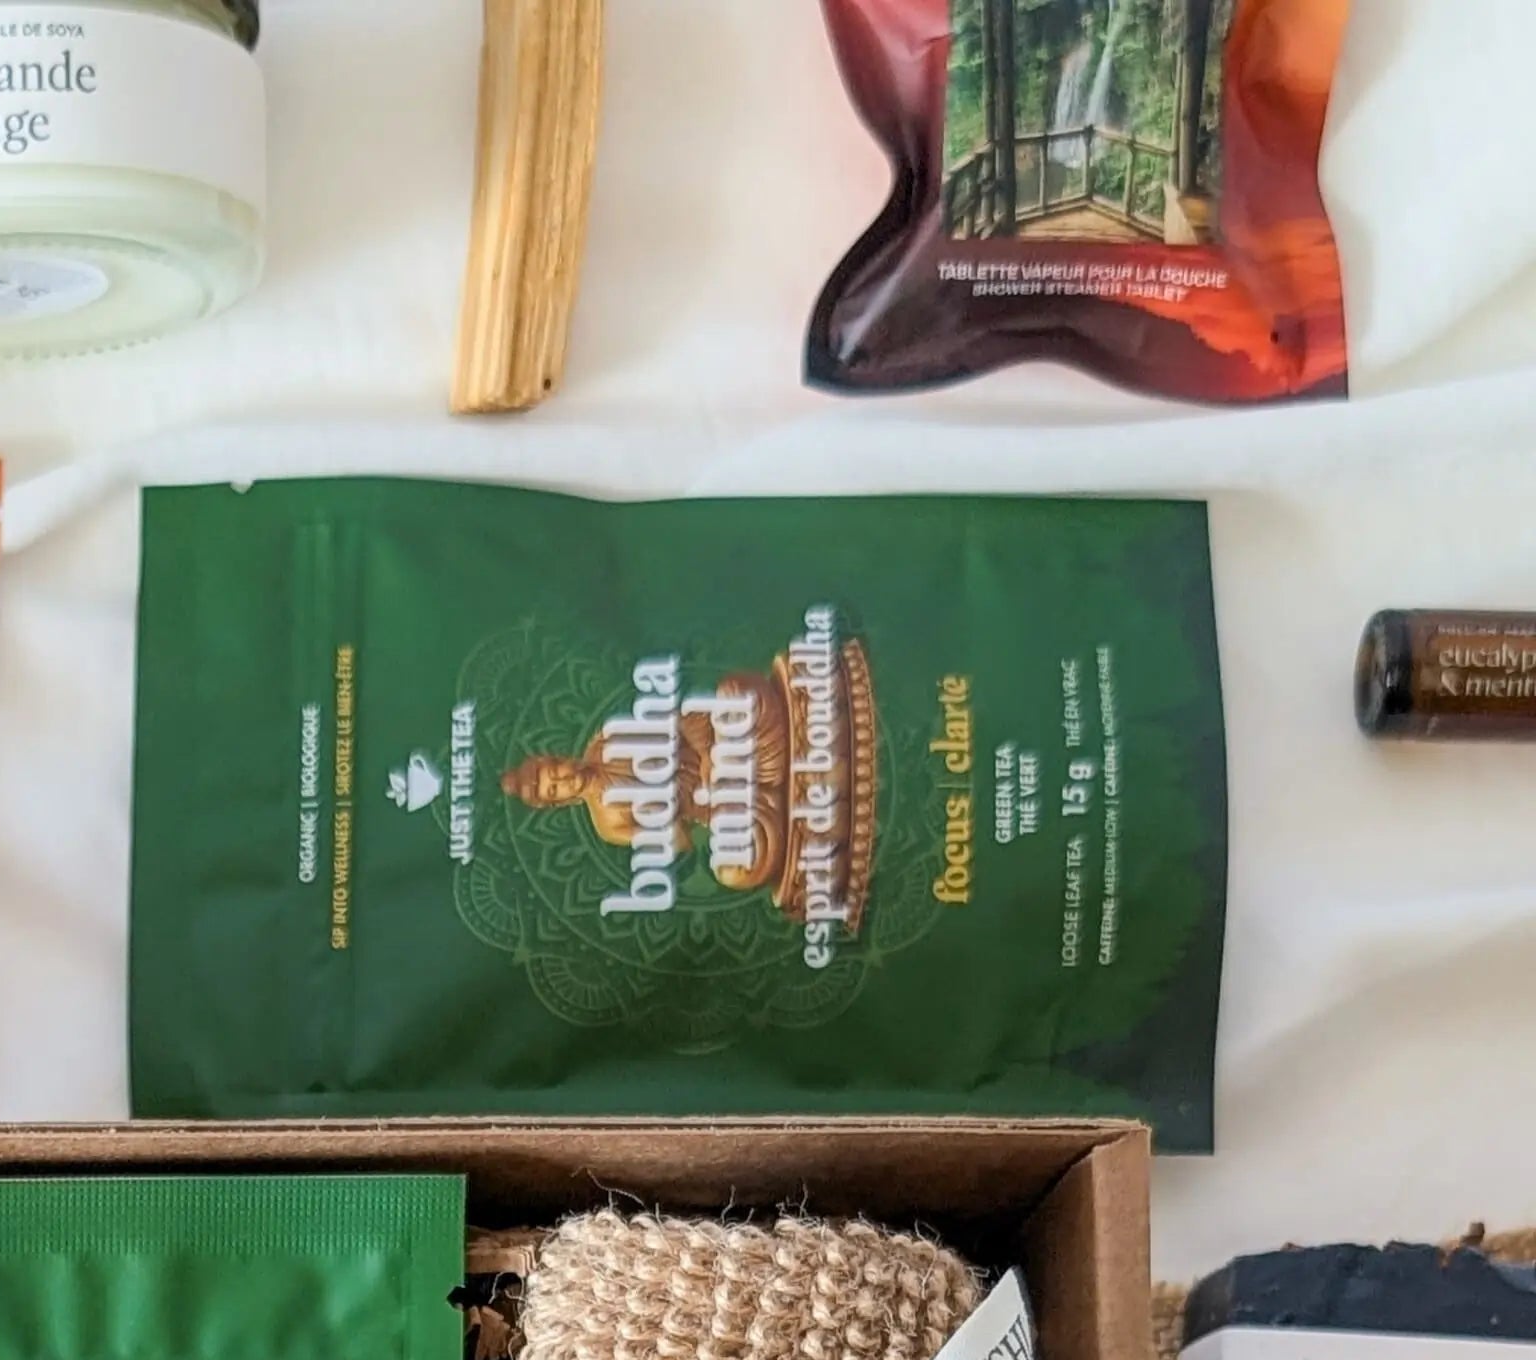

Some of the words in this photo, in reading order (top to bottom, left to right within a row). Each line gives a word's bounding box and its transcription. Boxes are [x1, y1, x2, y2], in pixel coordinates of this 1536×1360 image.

[22, 23, 43, 37] DE
[46, 23, 85, 39] SOYA
[938, 263, 1017, 281] TABLETTE
[1136, 267, 1156, 283] LA
[789, 604, 833, 775] bouddha
[452, 703, 477, 752] TEA
[929, 674, 971, 773] clarté
[451, 752, 475, 803] THE
[600, 652, 680, 915] buddha
[681, 695, 758, 872] mind
[995, 744, 1015, 777] TEA
[1019, 753, 1038, 797] VERT
[449, 804, 474, 865] JUST
[791, 783, 834, 833] de
[995, 781, 1014, 843] GREEN
[1017, 799, 1038, 835] THÉ
[933, 796, 971, 905] focus
[797, 841, 851, 968] esprit
